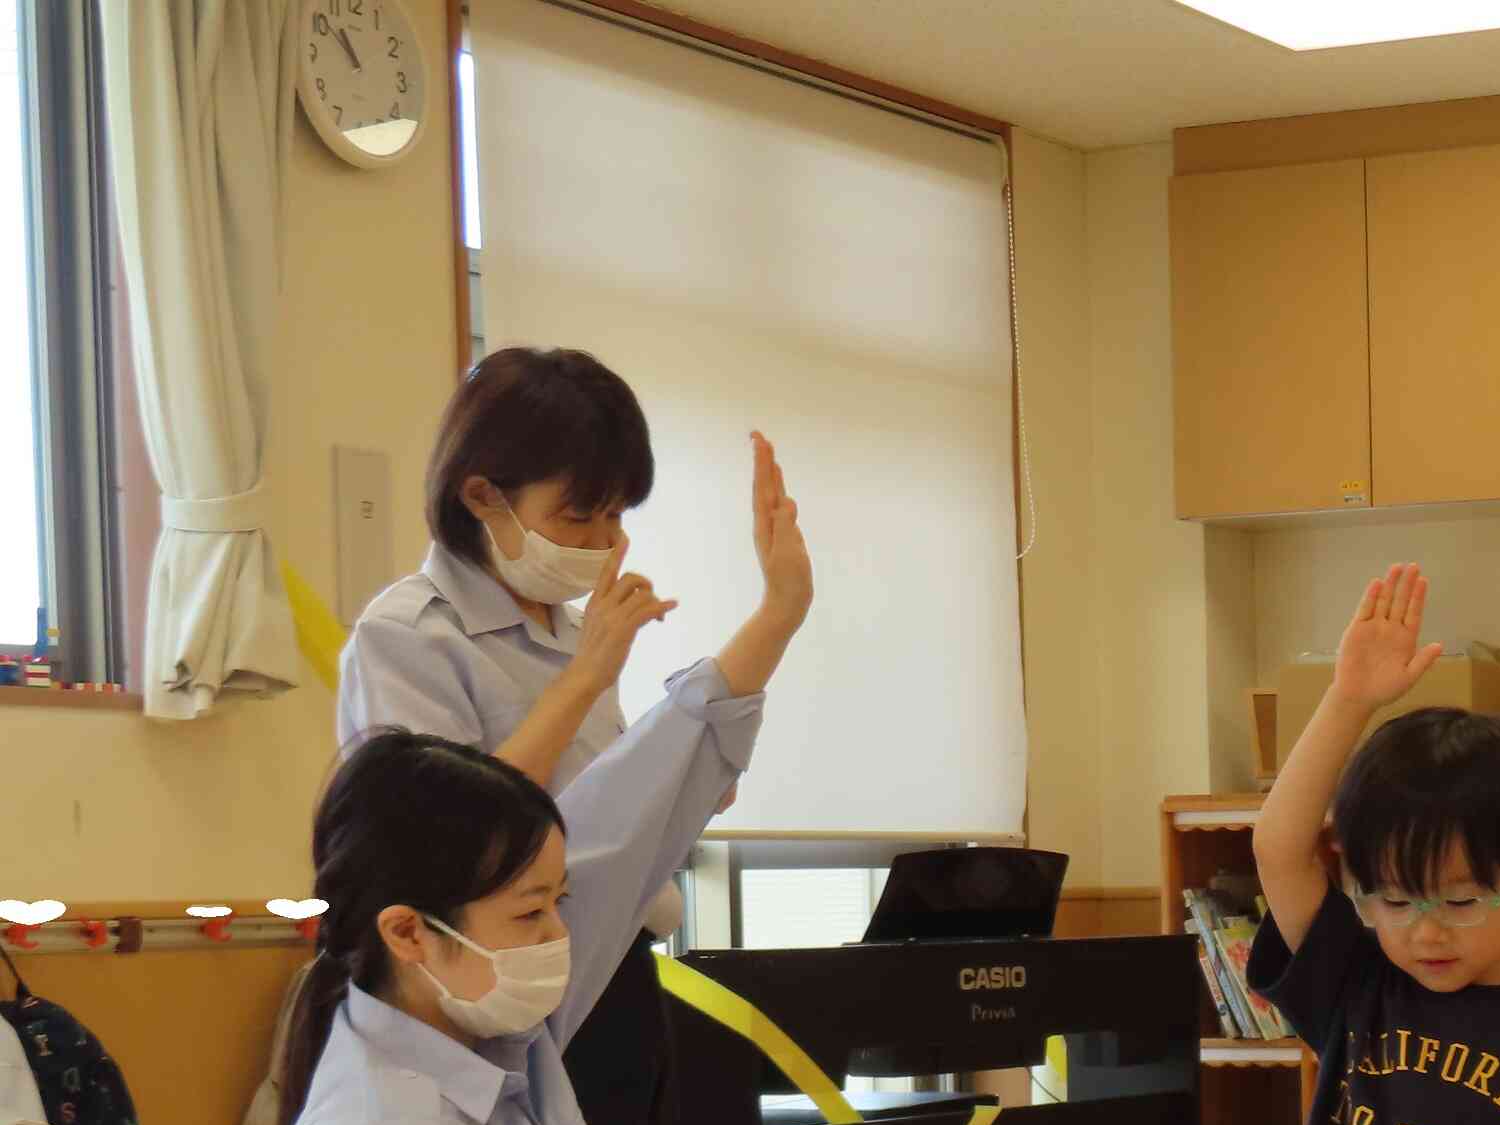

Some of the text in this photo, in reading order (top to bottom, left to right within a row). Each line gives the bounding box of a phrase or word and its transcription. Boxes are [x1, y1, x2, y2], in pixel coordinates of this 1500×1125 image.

[347, 0, 363, 16] 12
[312, 12, 330, 36] 10
[373, 9, 380, 31] 1
[387, 36, 399, 59] 2
[396, 71, 408, 94] 3
[331, 104, 343, 127] 7
[960, 965, 1026, 990] CASIO
